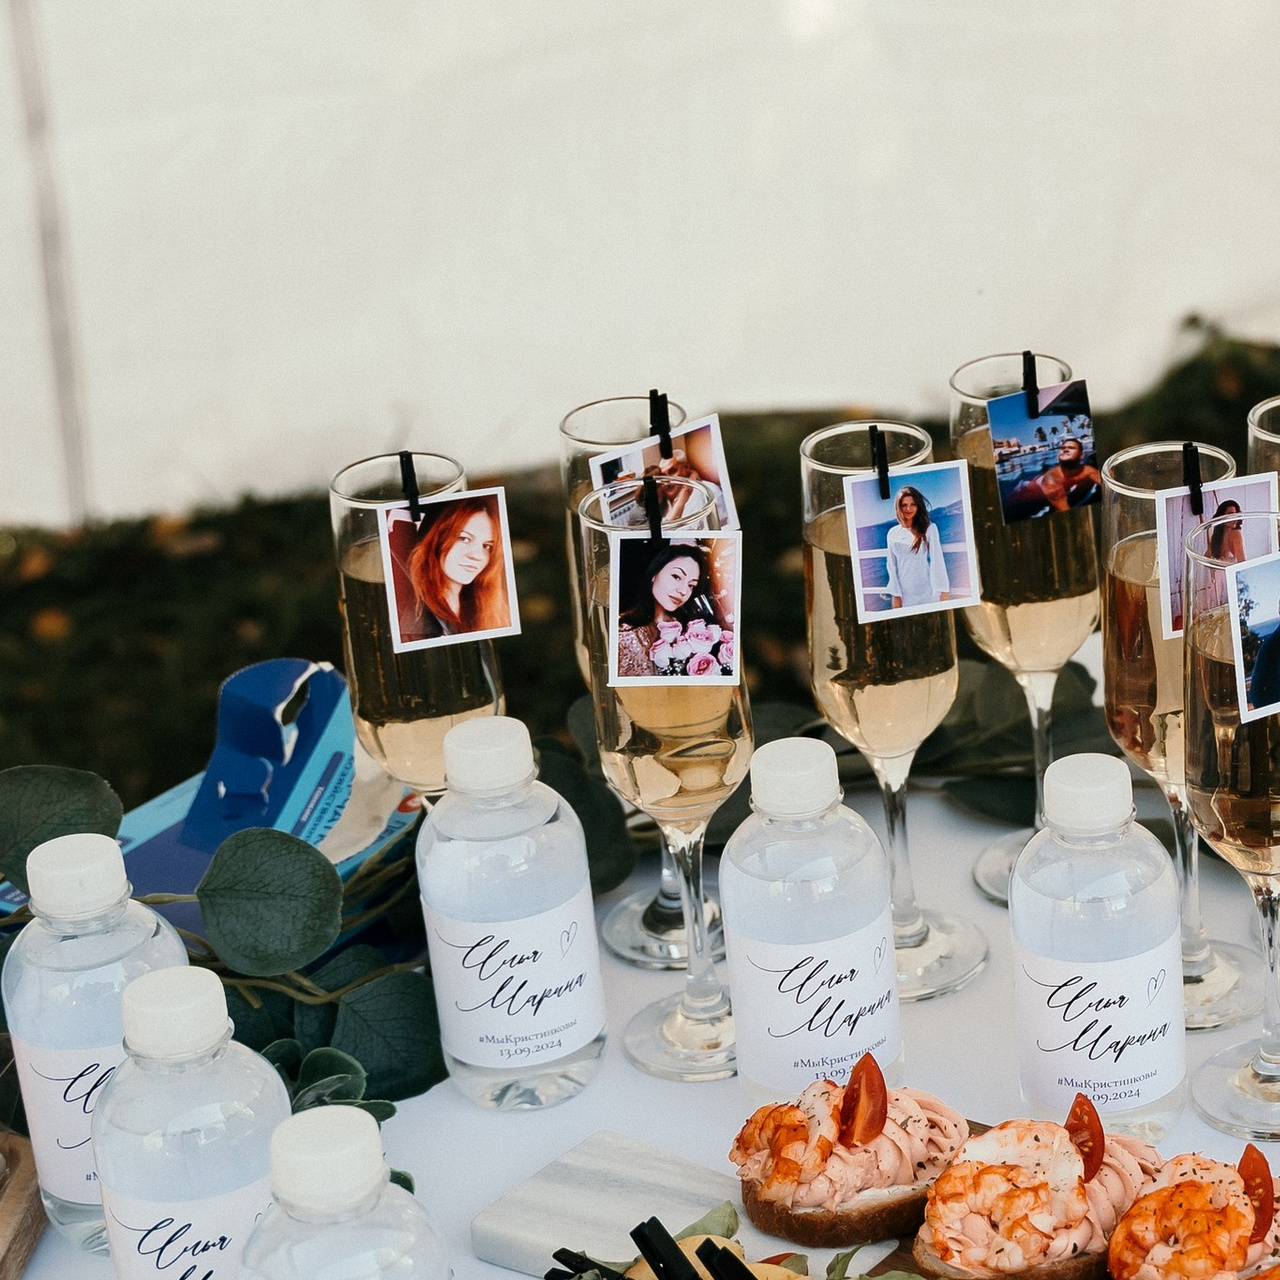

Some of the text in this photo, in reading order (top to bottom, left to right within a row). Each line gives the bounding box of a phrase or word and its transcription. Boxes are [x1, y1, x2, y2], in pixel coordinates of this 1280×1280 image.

[435, 928, 543, 981] Илья
[455, 972, 587, 1016] Марина
[746, 955, 860, 1004] Илья
[1022, 964, 1130, 1022] Илья
[479, 1019, 577, 1045] #МыКристинковы
[500, 1039, 562, 1060] 13.09.2024
[1037, 1019, 1171, 1063] Марина
[1057, 1069, 1158, 1092] #МыКристинковы
[1085, 1088, 1141, 1106] .09.2024
[109, 1206, 232, 1269] Илья
